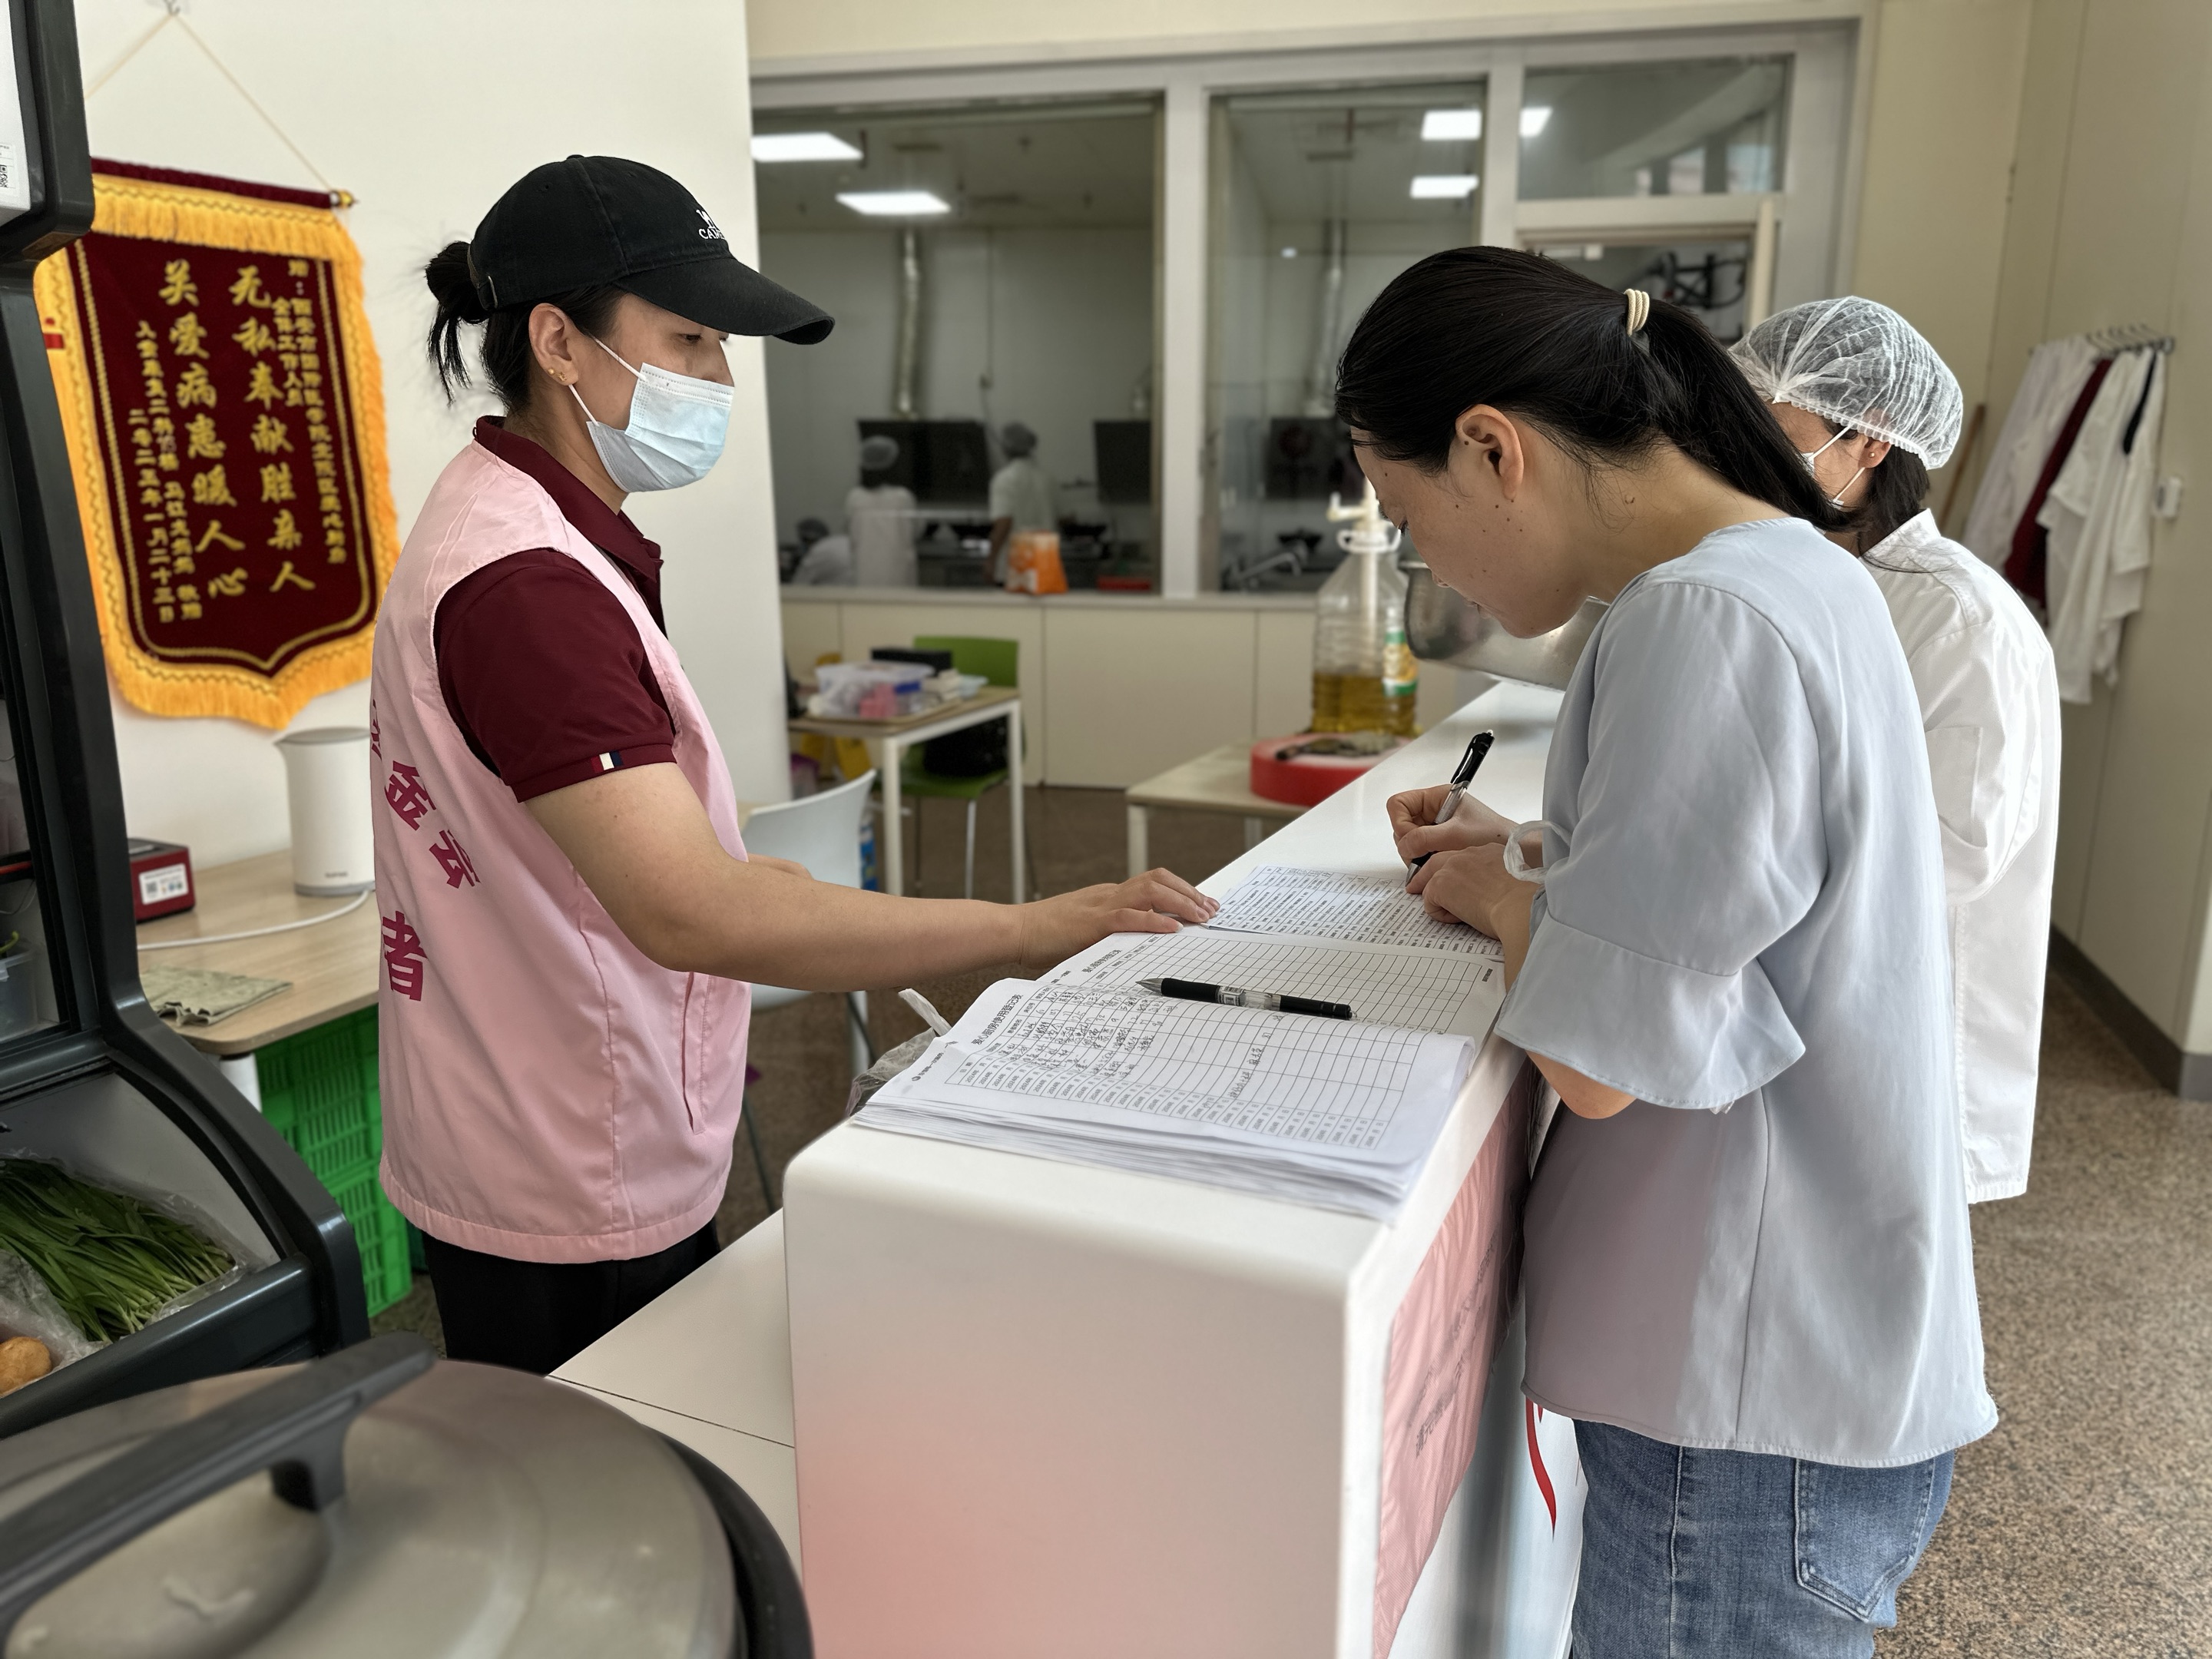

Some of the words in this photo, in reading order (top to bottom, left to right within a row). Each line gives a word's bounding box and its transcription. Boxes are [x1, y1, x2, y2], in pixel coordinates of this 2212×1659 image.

[159, 258, 248, 598] 关爱病患暖人心
[230, 265, 316, 593] 无私奉献胜亲人
[382, 910, 428, 1002] 者
[972, 994, 1022, 1044] 爱心厨房使用登记表
[965, 1069, 979, 1083] 2024年
[978, 1071, 992, 1084] 2024年
[992, 1073, 1006, 1087] 2024年
[1005, 1075, 1019, 1088] 2024年
[1018, 1077, 1033, 1090] 2024年
[1032, 1078, 1047, 1092] 2024年
[1046, 1081, 1061, 1094] 2024年
[1060, 1083, 1075, 1096] 2024年
[1075, 1085, 1088, 1098] 2024年
[1088, 1088, 1102, 1100] 2024年
[1103, 1091, 1116, 1103] 2024年
[1117, 1093, 1131, 1105] 2024年
